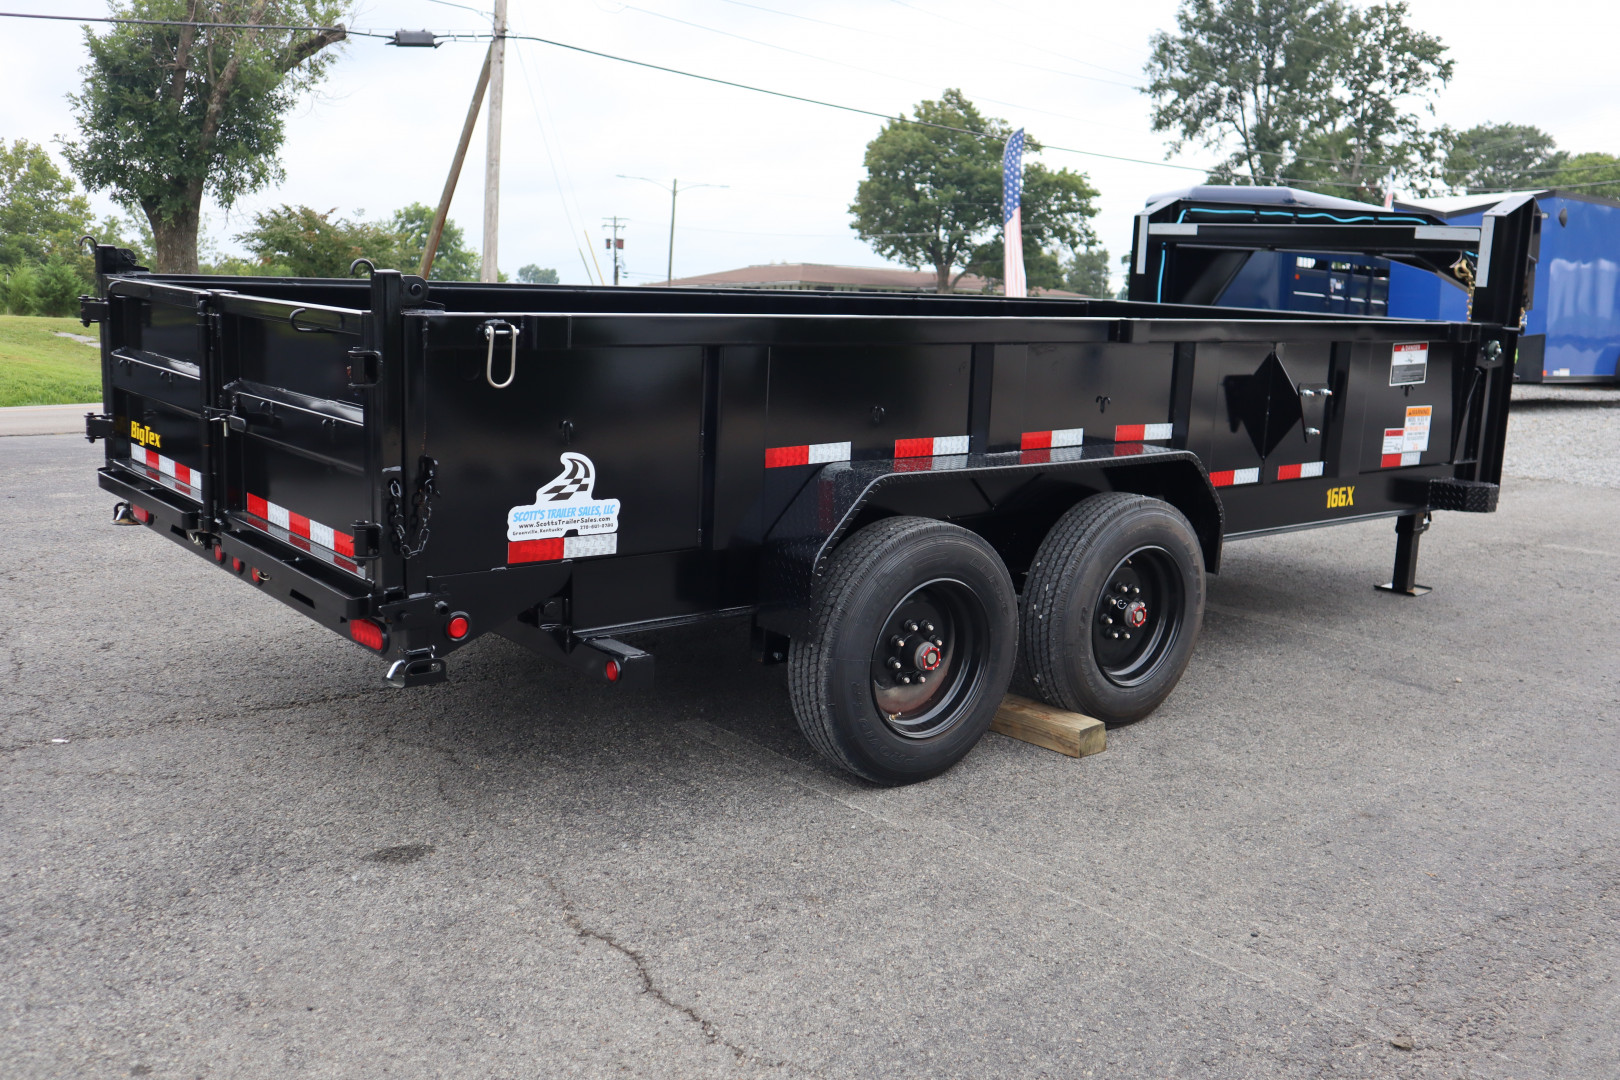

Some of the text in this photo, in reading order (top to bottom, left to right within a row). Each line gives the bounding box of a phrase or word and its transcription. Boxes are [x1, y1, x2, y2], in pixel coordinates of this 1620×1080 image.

[130, 420, 161, 448] BigTex
[1326, 485, 1355, 509] 16GX
[513, 504, 616, 522] SCOTT'S TRAILER SALES, LLC
[519, 517, 611, 529] www.ScottsTrailerSales.com
